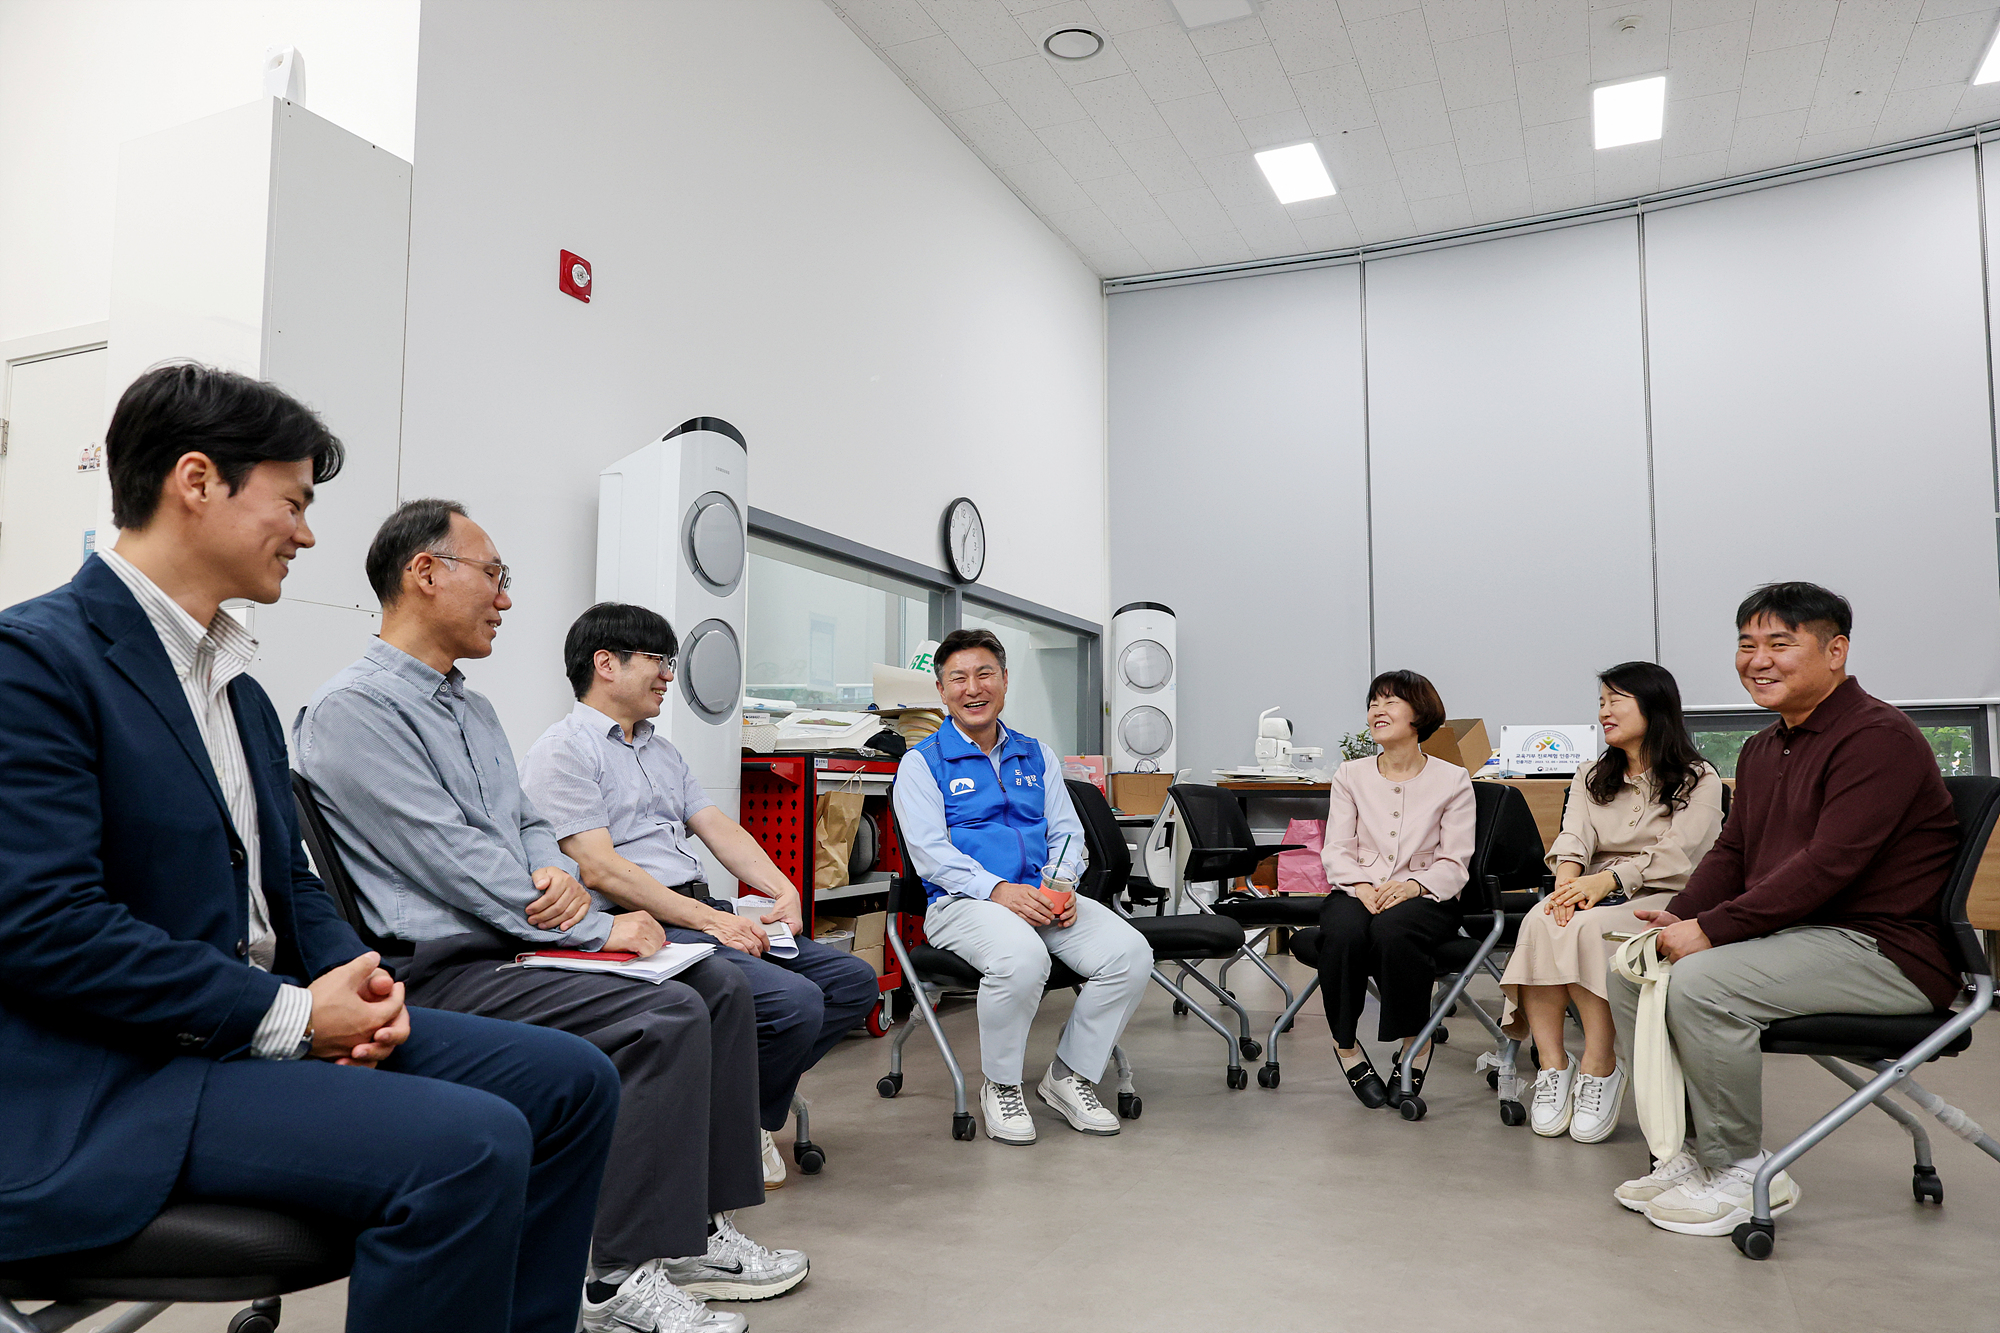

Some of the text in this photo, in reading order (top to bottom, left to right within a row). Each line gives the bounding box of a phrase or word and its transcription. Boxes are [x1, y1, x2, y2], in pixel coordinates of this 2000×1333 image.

[960, 564, 965, 574] 6
[966, 562, 970, 573] 5
[635, 1270, 647, 1286] NIKE
